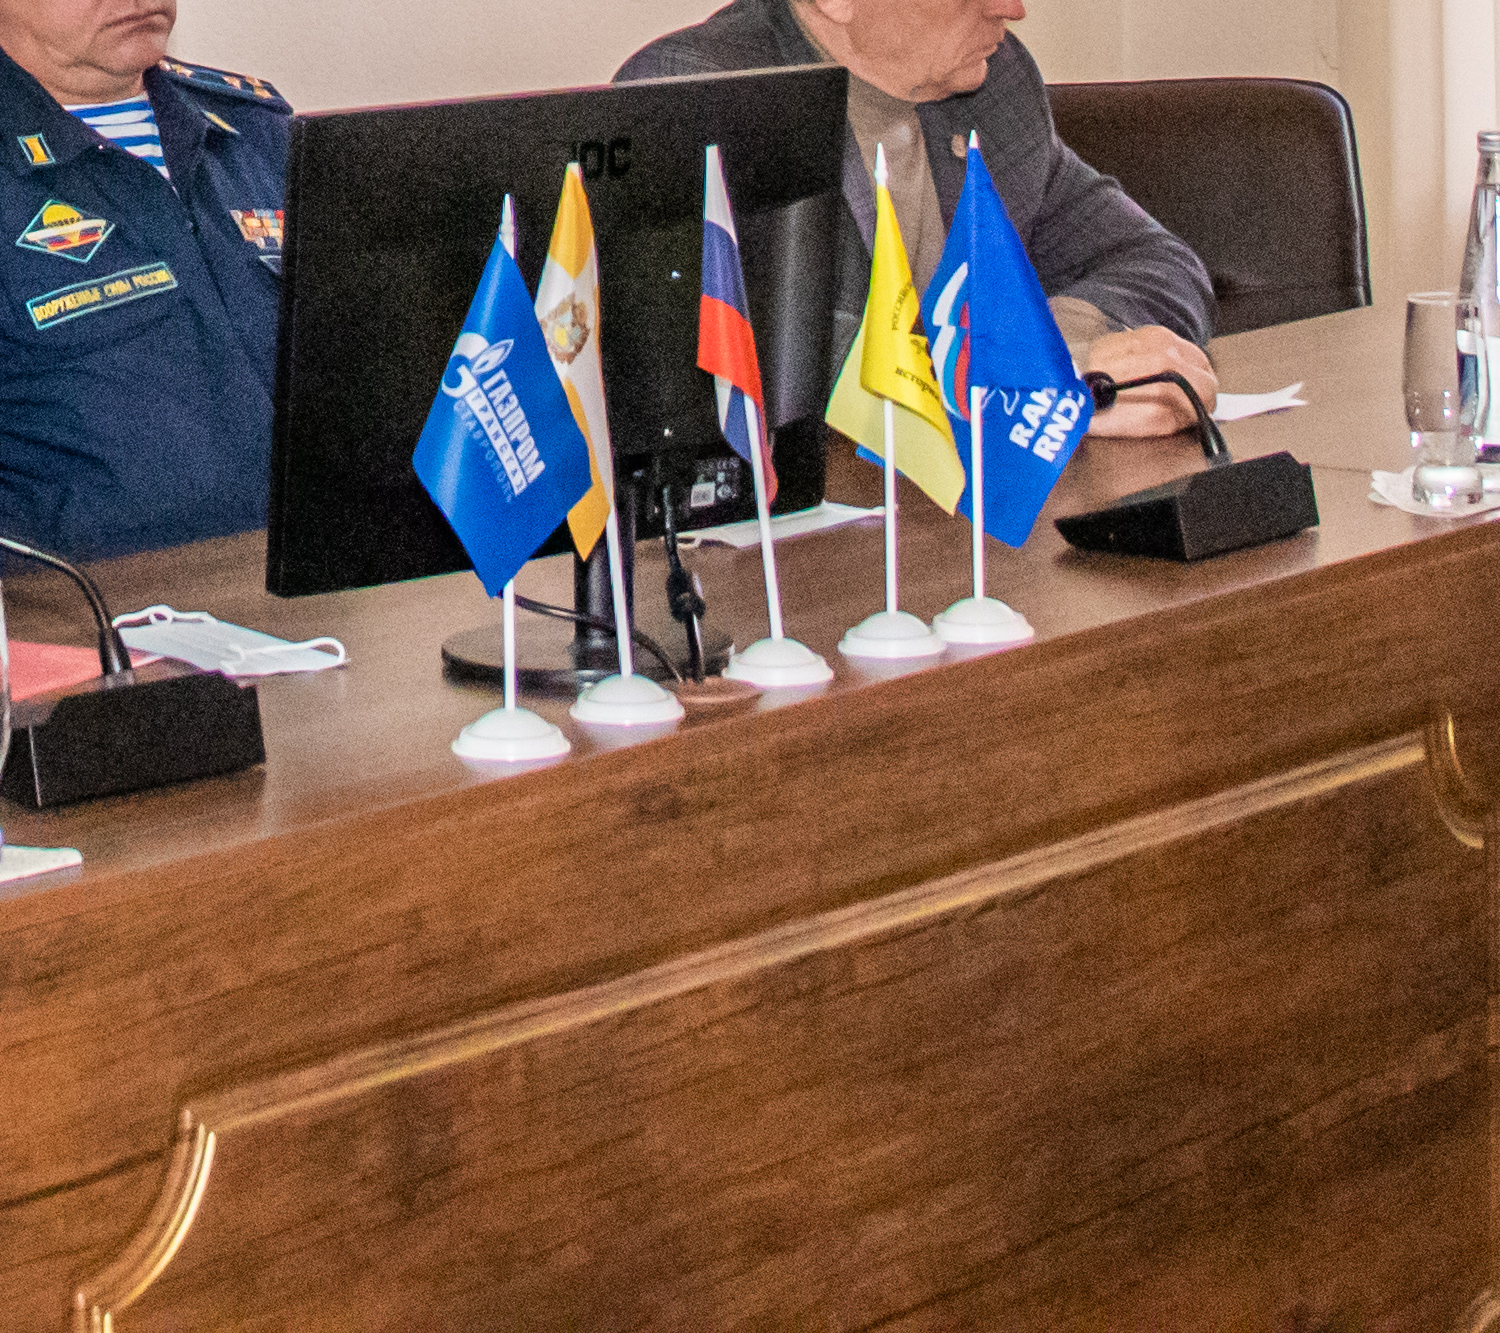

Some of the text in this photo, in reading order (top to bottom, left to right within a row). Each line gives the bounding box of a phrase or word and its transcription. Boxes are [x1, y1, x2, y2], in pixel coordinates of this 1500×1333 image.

[570, 136, 632, 180] OC
[473, 390, 526, 491] ТРАНСГАЗ
[482, 368, 546, 484] ГАЗПРОМ
